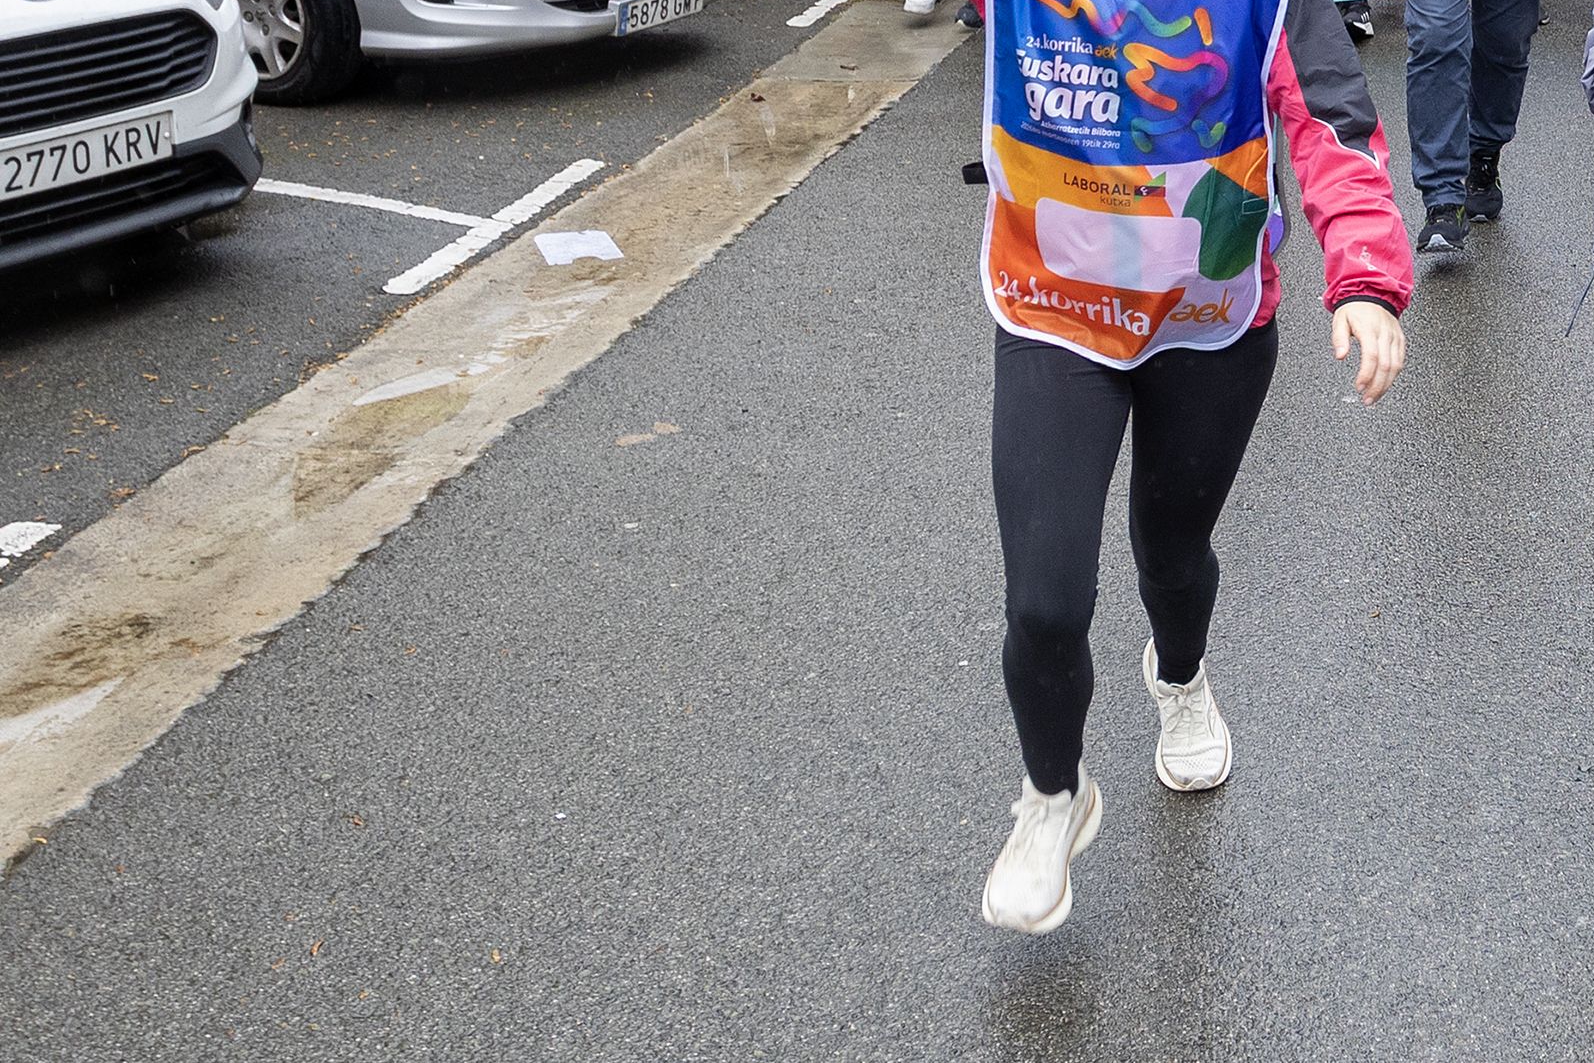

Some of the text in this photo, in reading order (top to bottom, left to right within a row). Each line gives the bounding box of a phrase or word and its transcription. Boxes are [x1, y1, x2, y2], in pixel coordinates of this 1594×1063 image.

[1026, 34, 1094, 55] 24.korrika
[1024, 82, 1121, 123] gara
[4, 120, 162, 193] 2770 KRV
[1063, 173, 1131, 196] LABORAL
[1100, 195, 1131, 207] kutxa
[994, 271, 1235, 336] 24.korrika aek
